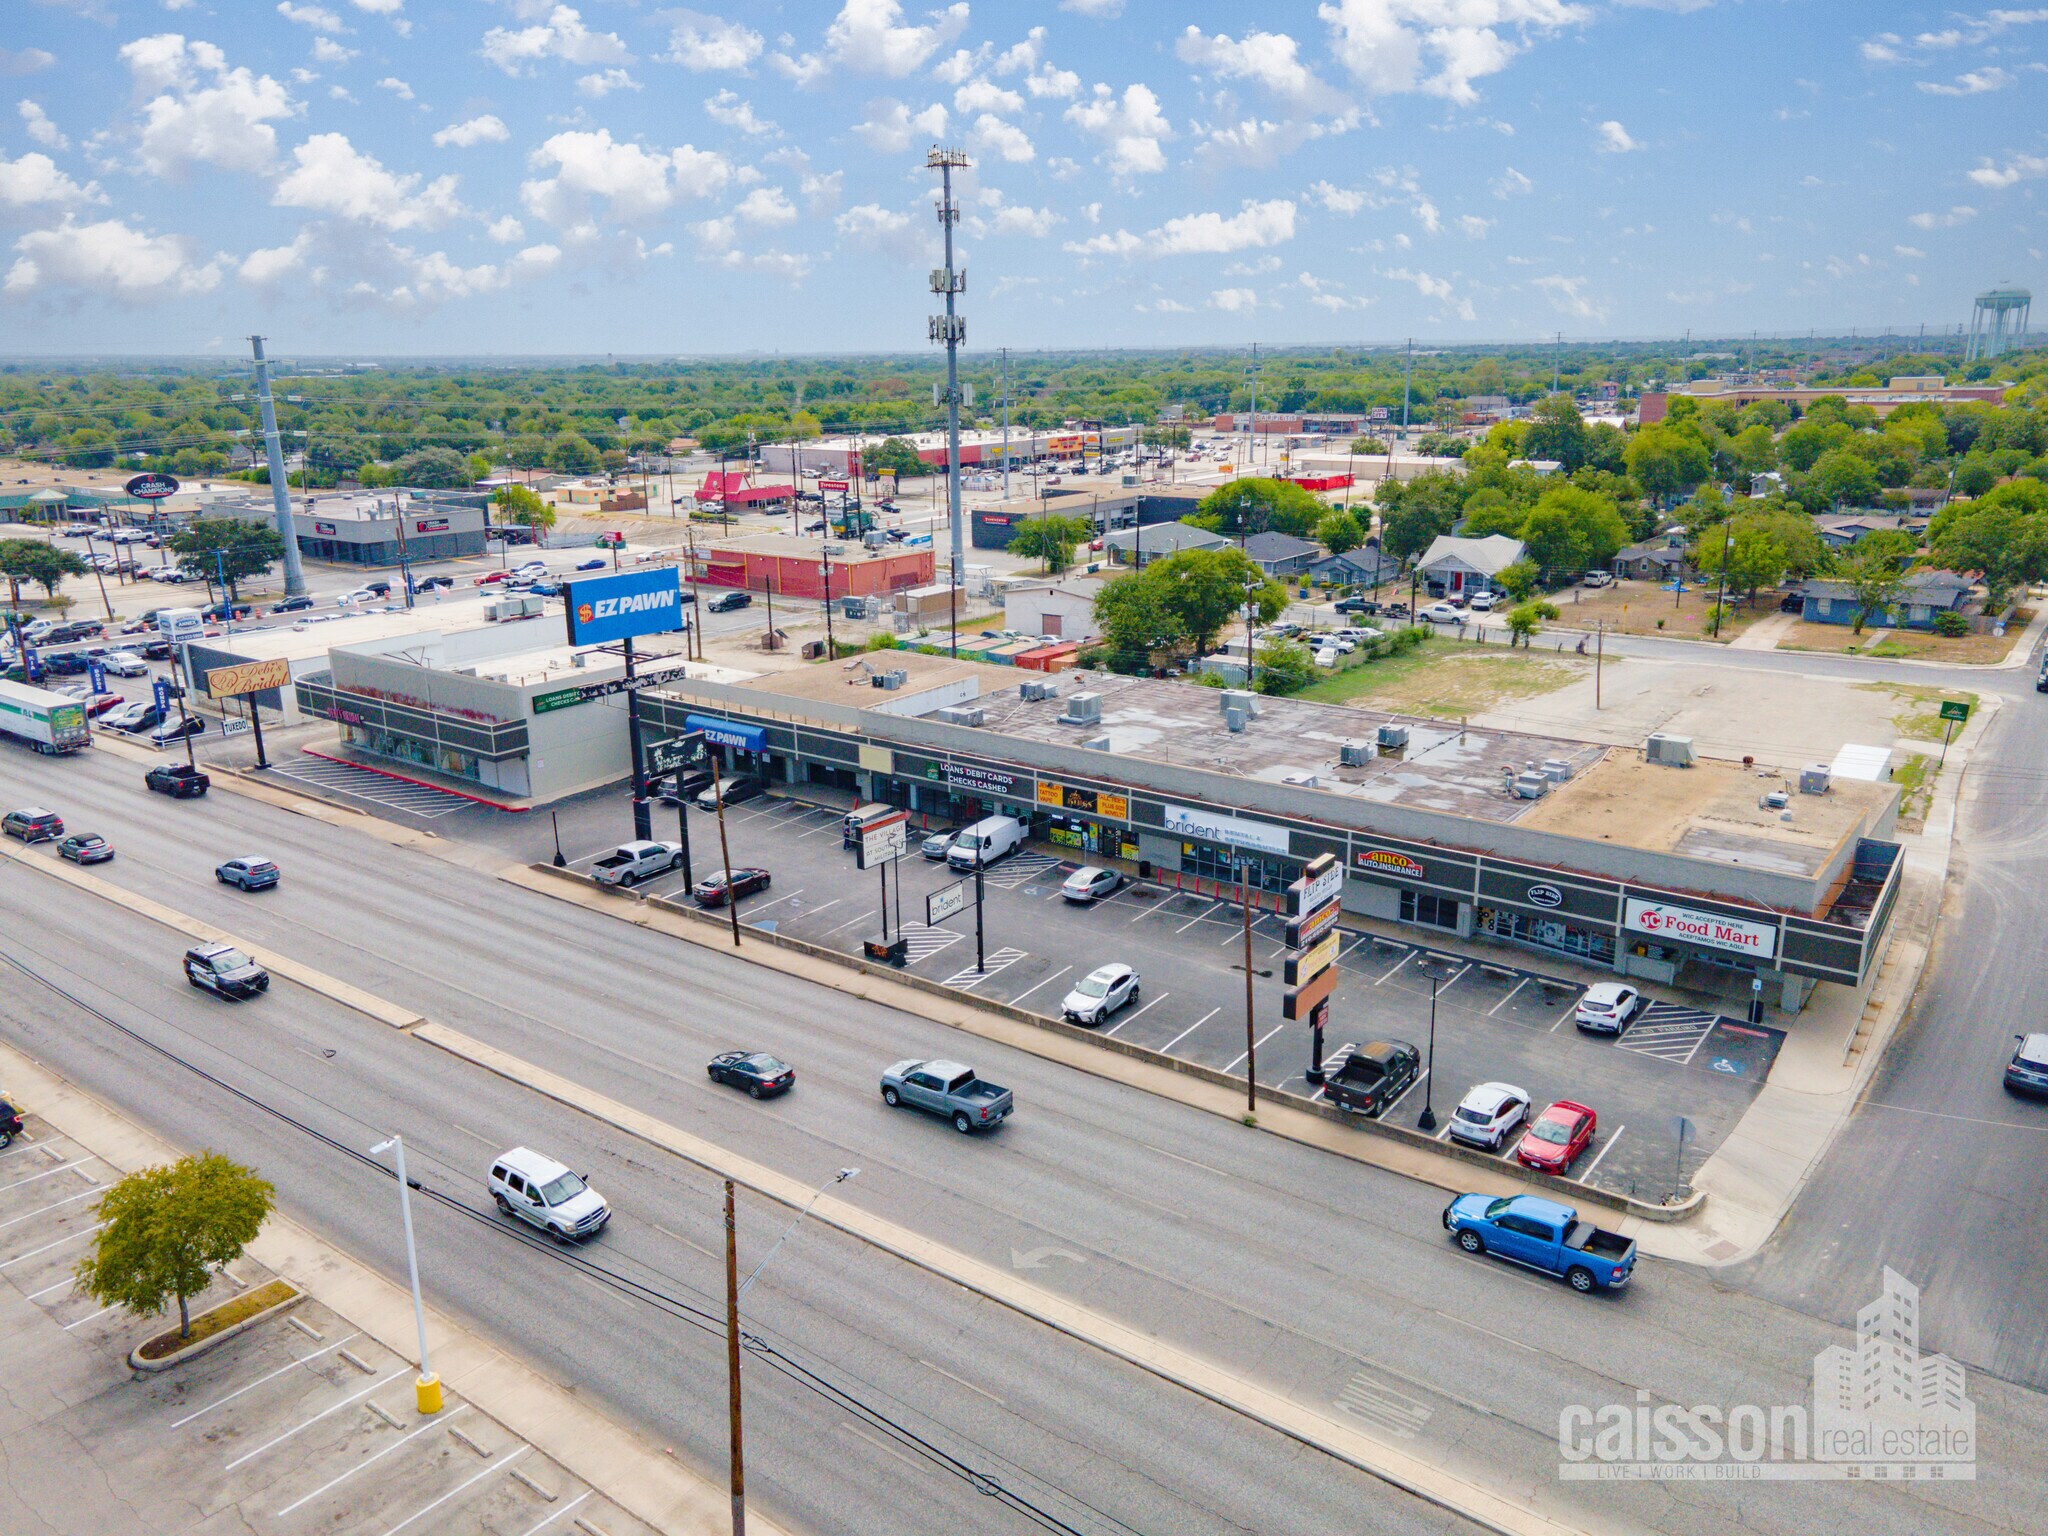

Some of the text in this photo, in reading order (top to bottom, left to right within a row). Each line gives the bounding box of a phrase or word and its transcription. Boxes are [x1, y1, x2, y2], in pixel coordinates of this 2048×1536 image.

[133, 486, 175, 495] CHAMPIONS
[240, 662, 282, 678] Debi's
[234, 671, 288, 694] Bridal
[158, 687, 166, 709] HONDA
[545, 694, 562, 702] LOANS
[551, 698, 569, 707] CHECKS
[225, 721, 247, 733] TUXEDO
[940, 763, 1013, 785] LOANS DEBIT CARDS
[948, 775, 1008, 793] CHECKS CASHED
[1040, 789, 1058, 798] TATTOO
[1102, 802, 1115, 810] PLUS
[1104, 810, 1126, 819] NOVELTY
[865, 824, 904, 843] THE VILLAGE
[1165, 816, 1222, 840] brident
[1359, 858, 1420, 877] AUTO INSURANCE
[1372, 852, 1407, 867] amco
[1303, 880, 1320, 899] FLIP
[1322, 866, 1340, 887] SIDE
[931, 894, 962, 916] brident
[1664, 915, 1760, 947] Food Mart
[1695, 915, 1727, 926] ACCEPTED
[1727, 921, 1744, 930] HERE
[1678, 932, 1745, 951] ACEPTAMOS WIC AQUI
[1657, 1024, 1699, 1033] PARKING
